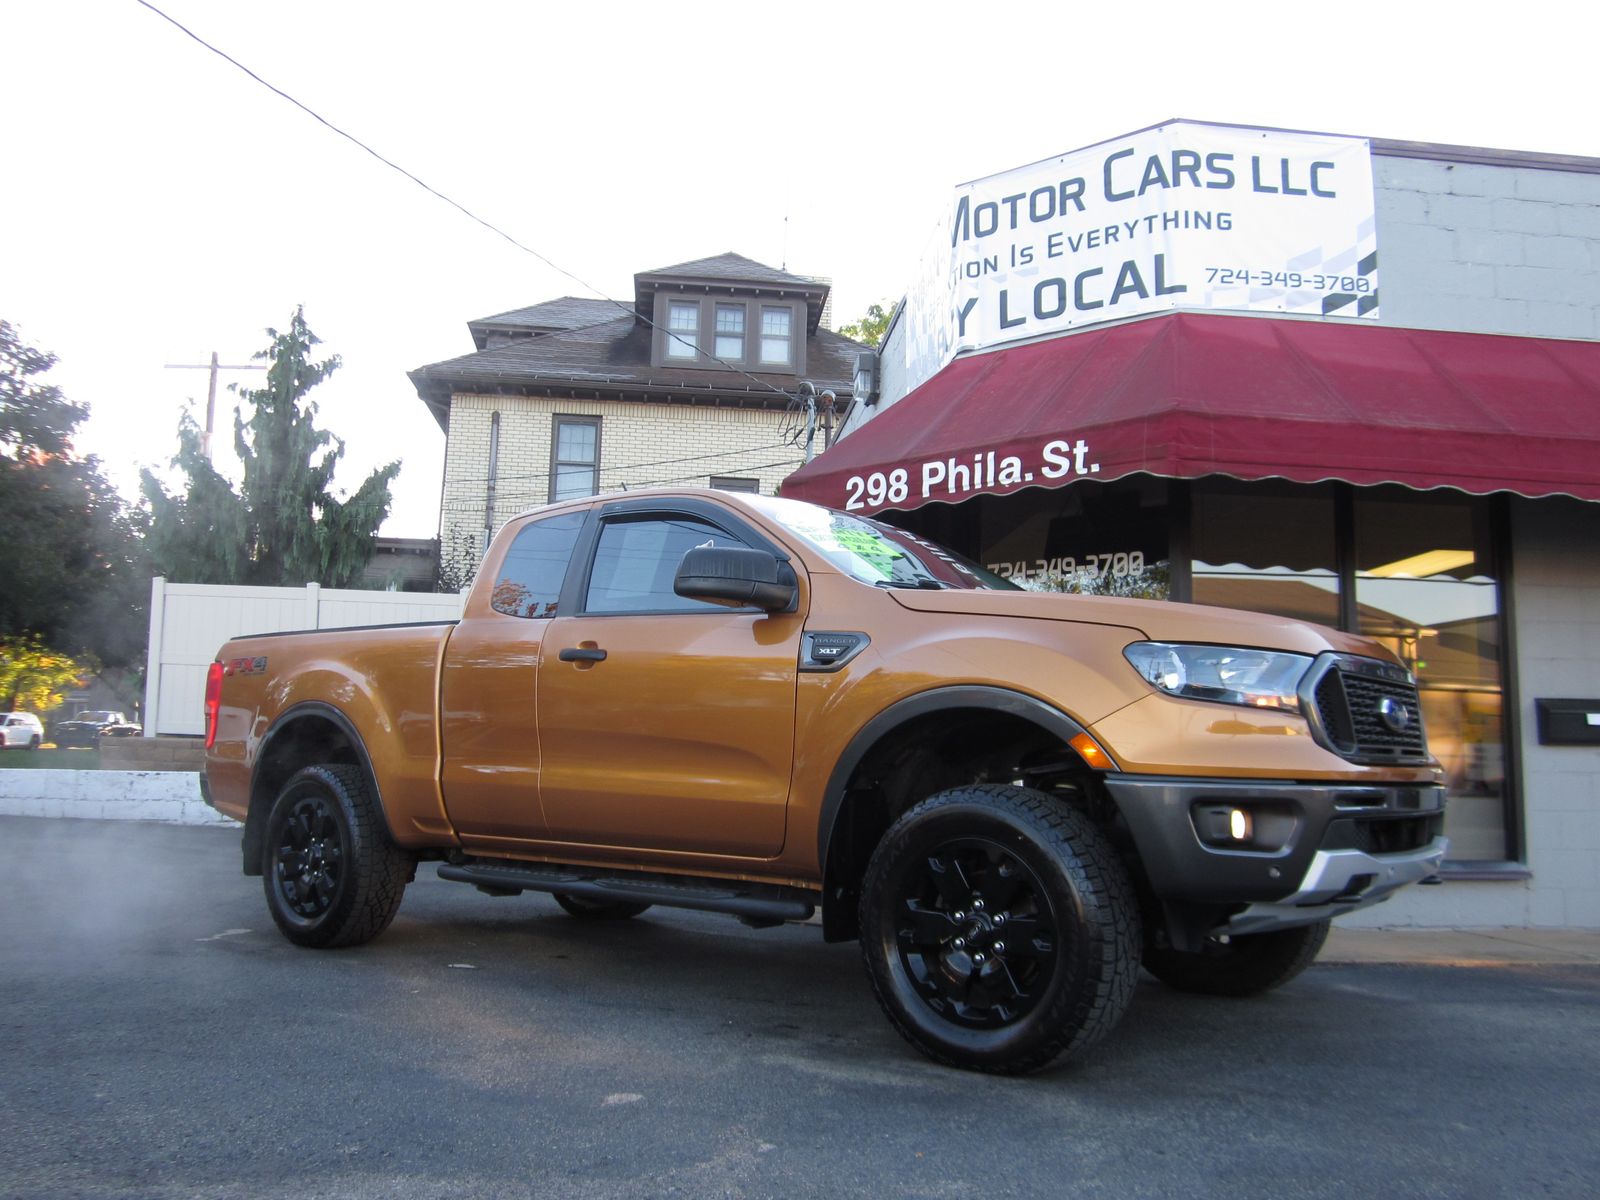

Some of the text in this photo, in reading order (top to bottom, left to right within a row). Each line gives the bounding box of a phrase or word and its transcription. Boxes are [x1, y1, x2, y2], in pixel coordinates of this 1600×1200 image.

[1103, 147, 1236, 203] CARS
[1251, 155, 1337, 199] LLC
[1011, 244, 1034, 268] IS
[1047, 210, 1233, 260] EVERYTHING
[999, 253, 1188, 330] LOCAL
[1205, 267, 1370, 293] 724-349-3700
[845, 439, 1100, 511] 298 Phila. St.
